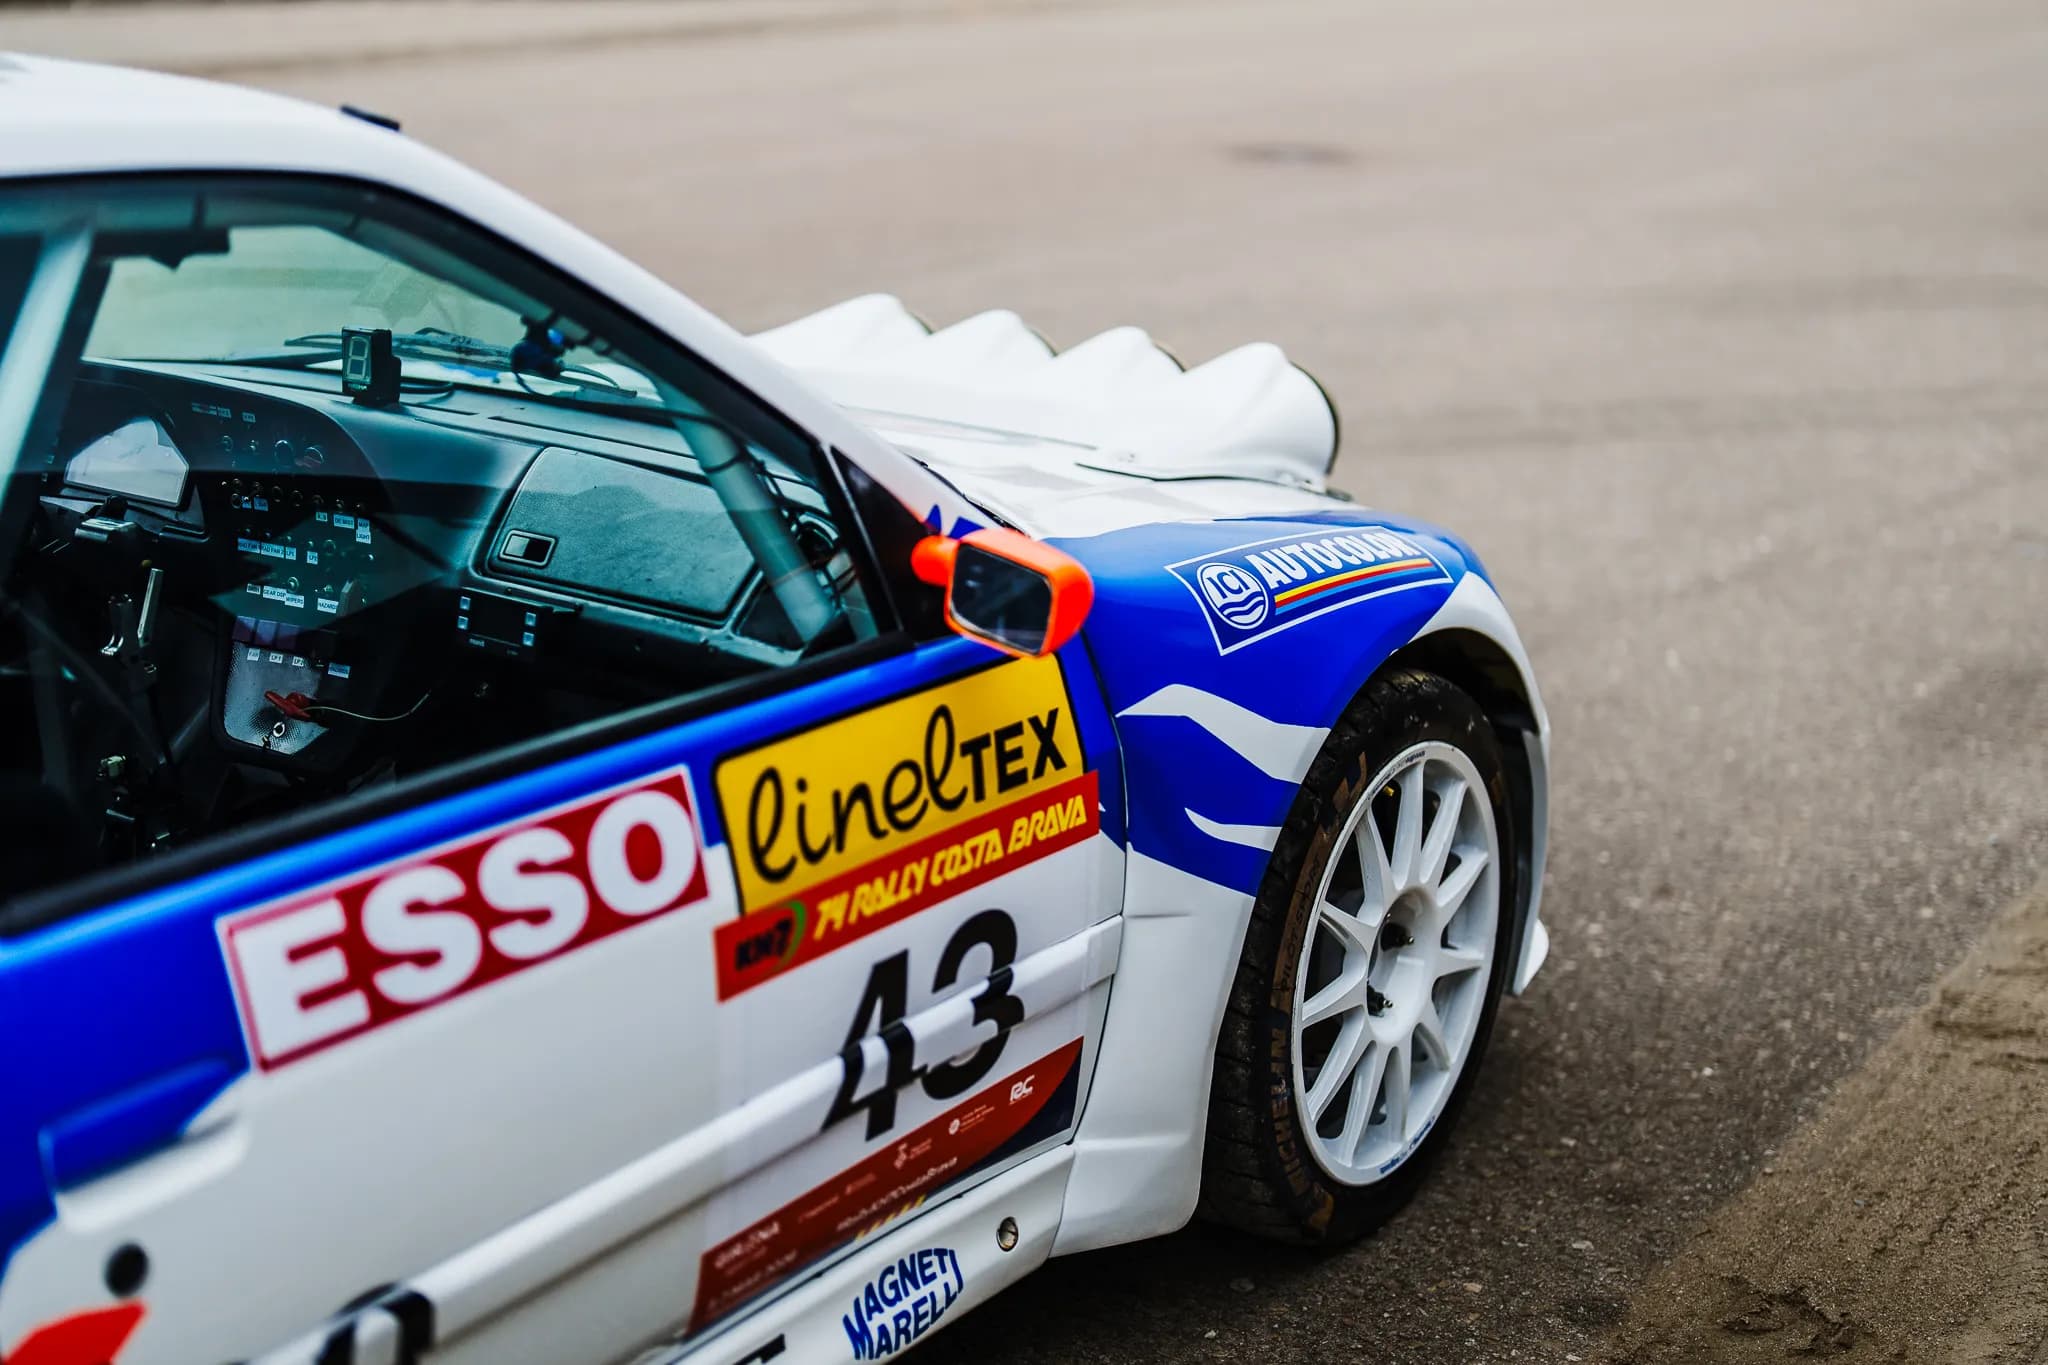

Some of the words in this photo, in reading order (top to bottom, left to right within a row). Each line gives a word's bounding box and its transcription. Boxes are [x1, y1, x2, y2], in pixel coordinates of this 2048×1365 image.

[1207, 569, 1250, 601] ICI
[1245, 531, 1421, 589] AUTOCOLOR
[848, 857, 929, 925] RALLY
[929, 827, 1004, 887] COSTA
[1007, 794, 1088, 855] BRAVA
[231, 790, 698, 1062] ESSO
[820, 908, 1025, 1143] 43
[843, 1247, 964, 1358] MAGNETI
